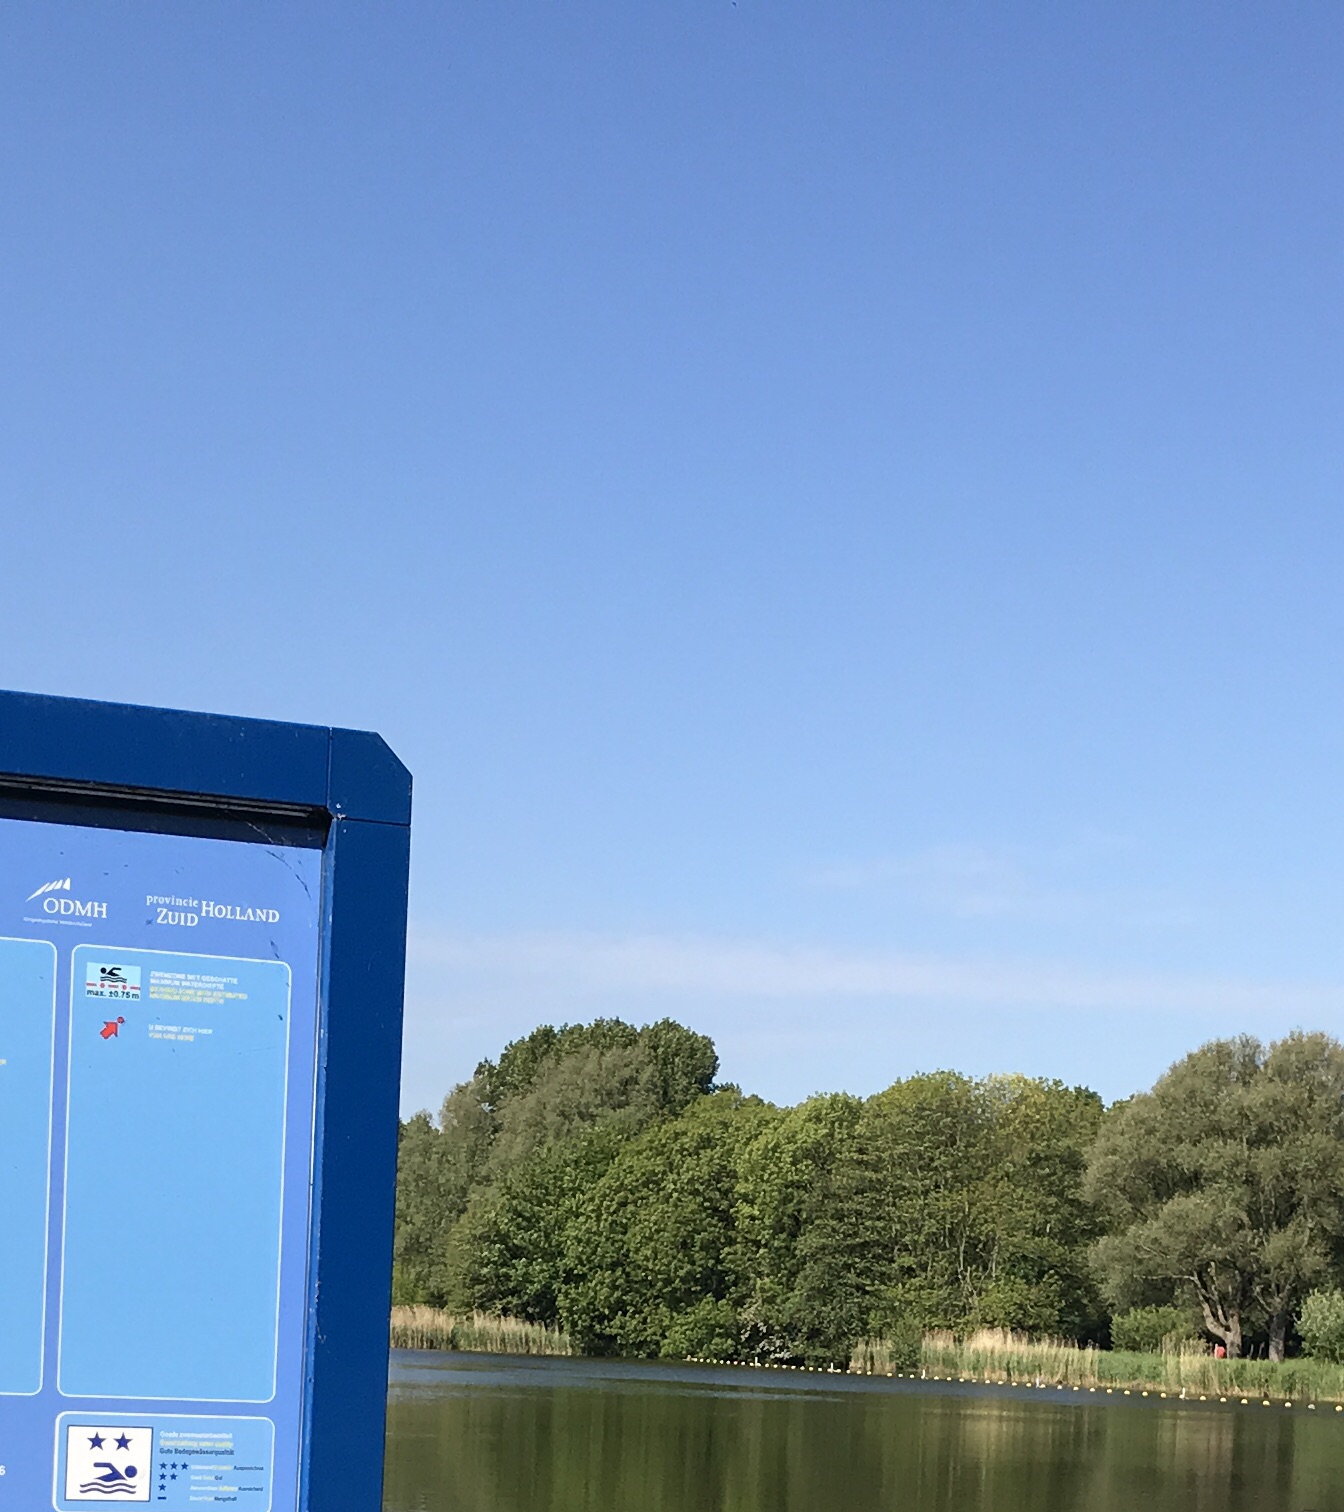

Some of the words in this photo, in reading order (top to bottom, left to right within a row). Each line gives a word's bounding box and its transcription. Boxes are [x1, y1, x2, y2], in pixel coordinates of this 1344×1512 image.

[43, 897, 107, 918] ODMH
[146, 895, 198, 907] provincie
[156, 907, 198, 926] ZUID
[200, 900, 279, 922] HOLLAND
[86, 989, 106, 998] max.
[108, 990, 130, 998] ±0.75
